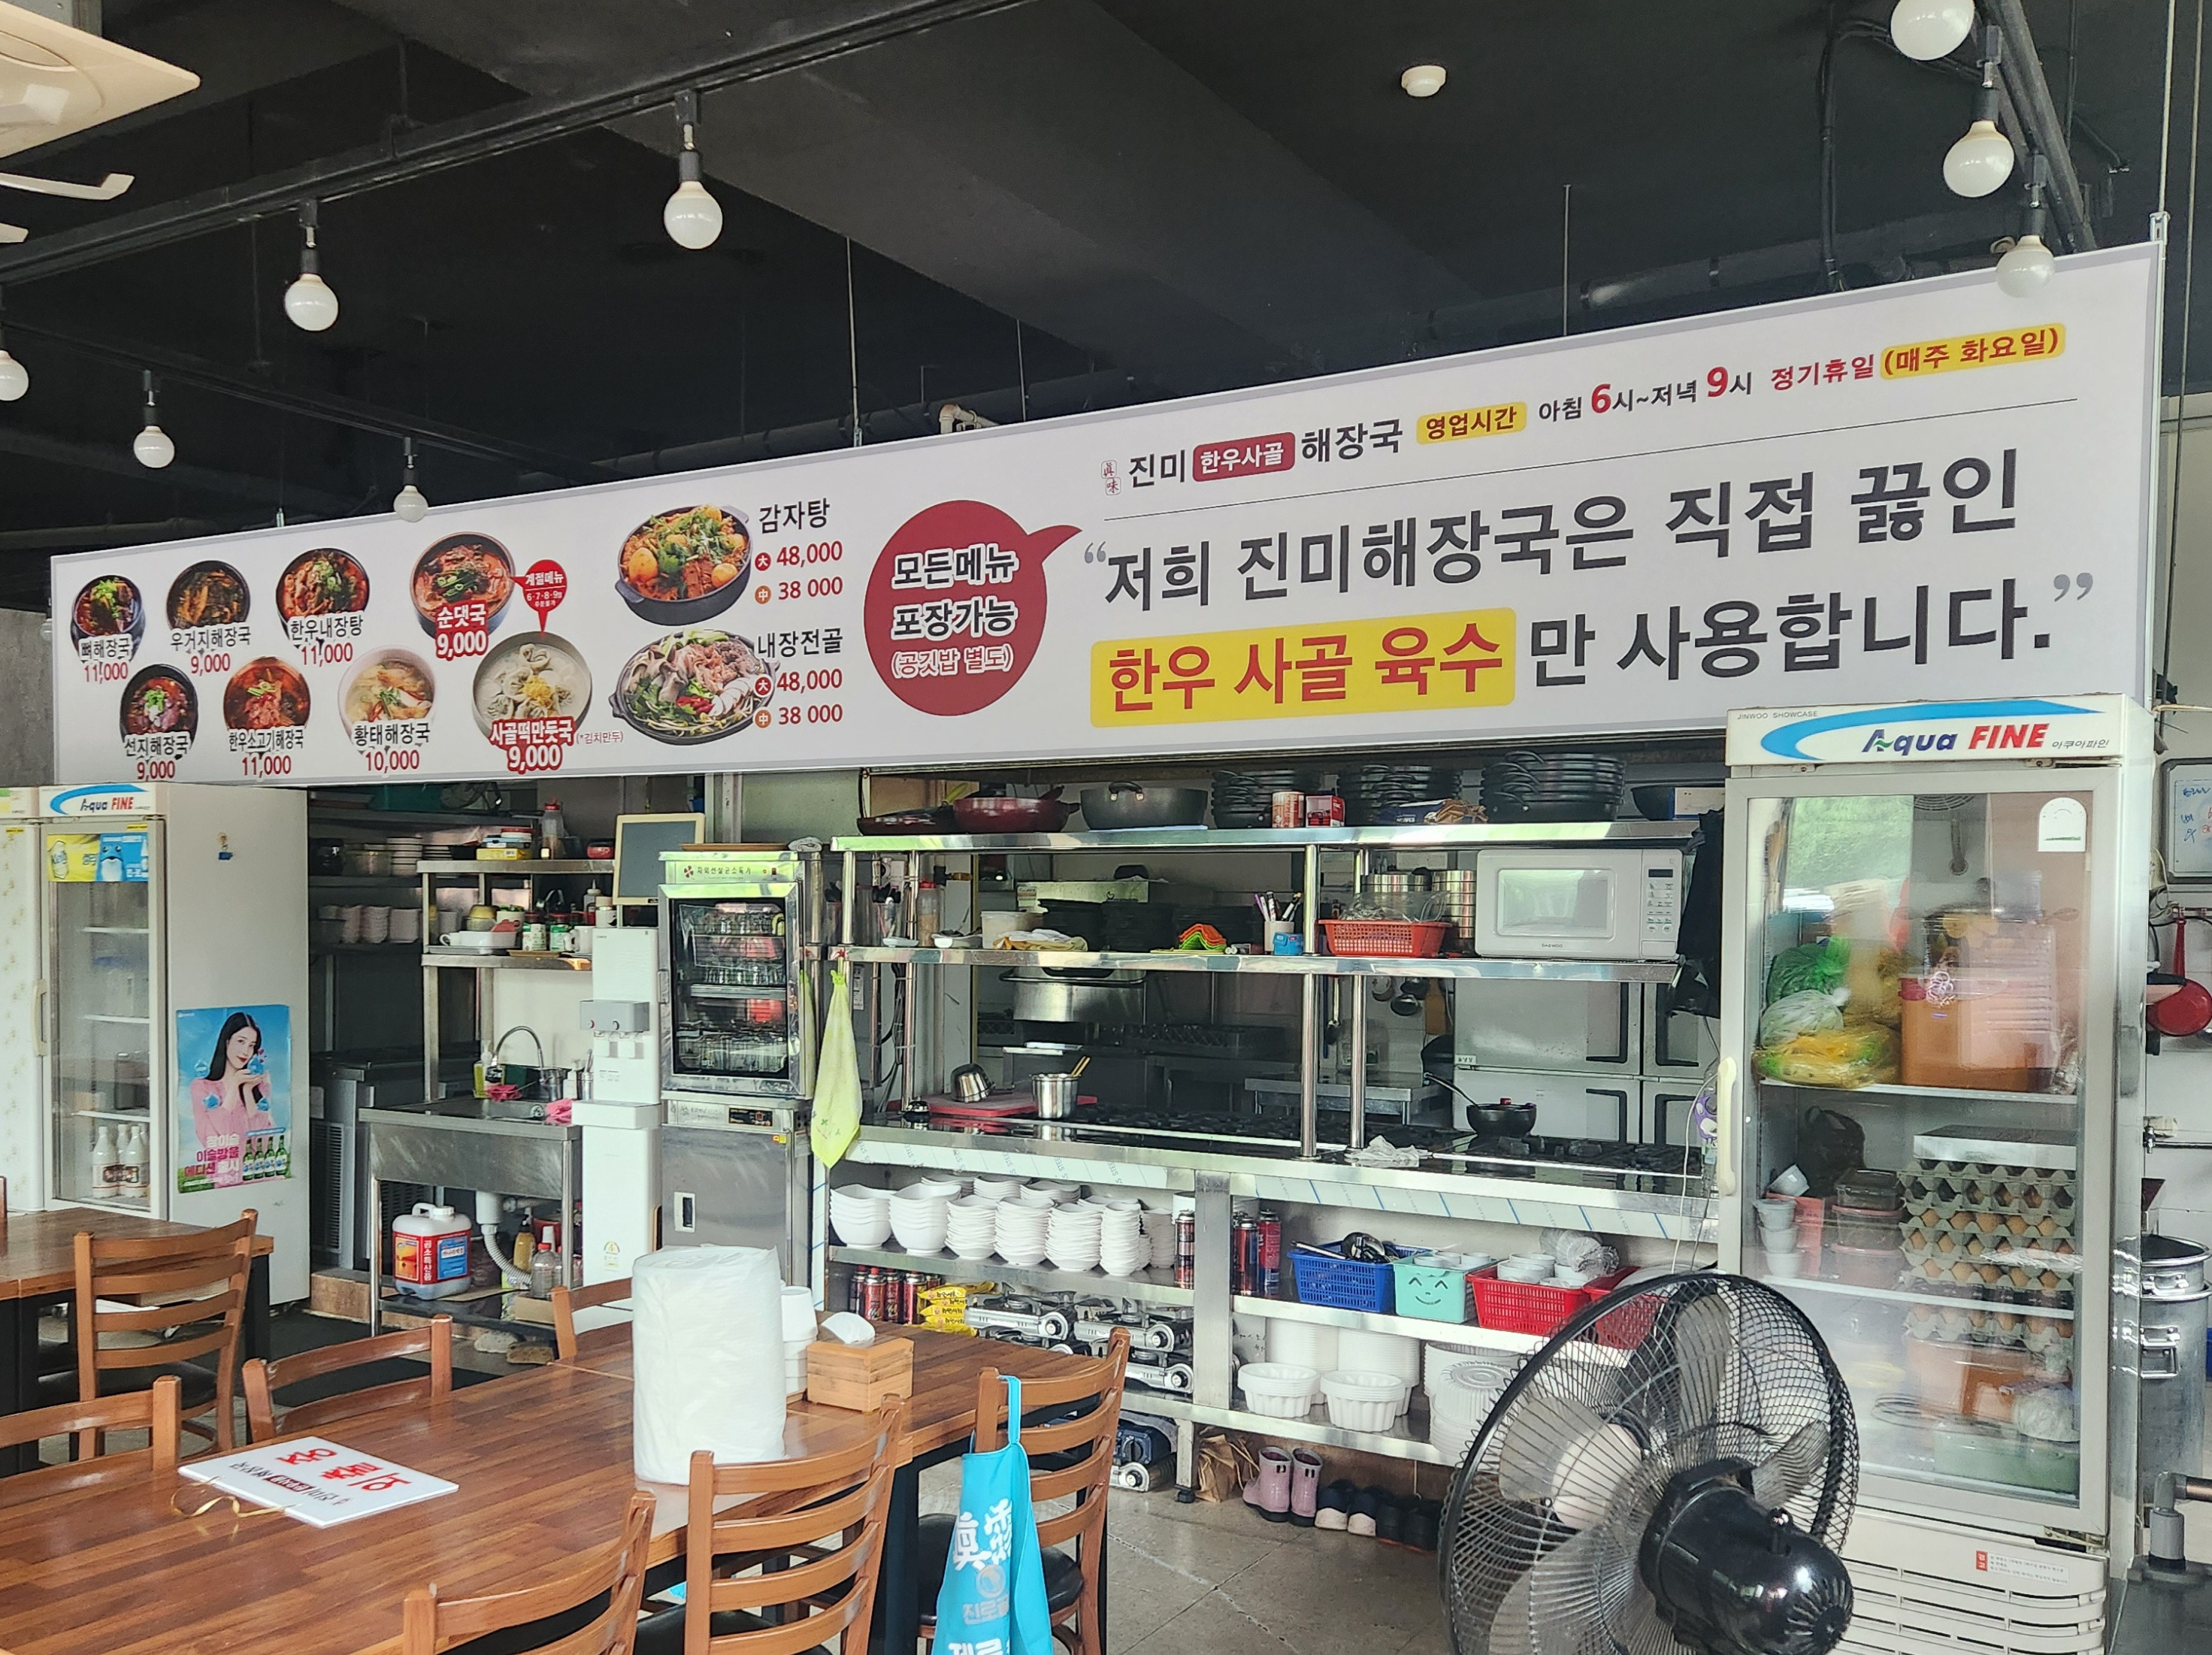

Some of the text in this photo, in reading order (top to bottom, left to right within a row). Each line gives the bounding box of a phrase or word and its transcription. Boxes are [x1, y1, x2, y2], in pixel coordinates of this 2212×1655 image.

[1770, 326, 2059, 392] 정기휴일 (매주 화요일)
[1426, 407, 1517, 440] 영업시간
[1539, 396, 1582, 422] 아침
[1707, 366, 1752, 398] 9시
[1129, 419, 1403, 488] 진미 한우사골 해장국
[758, 498, 831, 534] 감자탕
[1238, 496, 1634, 601] 진미해장국은
[1666, 471, 1814, 558] 직접
[1850, 448, 2017, 544] 끓인
[776, 540, 843, 567] 48,000
[894, 544, 1017, 586] 모든메뉴
[289, 614, 364, 643] 한우내장탕
[437, 604, 486, 630] 순댓국
[894, 600, 1015, 636] 포장가능
[80, 638, 130, 659] 뼈해장국
[170, 625, 251, 651] 우거지해장국
[437, 631, 486, 658] 9,000
[757, 628, 843, 659] 내장전골
[191, 652, 231, 676] 9,000
[301, 642, 353, 665] 11,000
[892, 644, 1014, 678] (공깃밥 별도)
[1109, 646, 1215, 712] 한우
[1234, 634, 1353, 704] 사골
[1375, 623, 1502, 696] 육수
[1530, 613, 1596, 688] 만
[84, 662, 129, 684] 11,000
[776, 668, 843, 694] 48,000
[123, 734, 189, 757] 선지해장국
[228, 728, 304, 752] 한우소고기해장국
[353, 722, 431, 747] 황태해장국
[1862, 723, 2109, 755] Aqua FINE 아쿠아파인
[136, 760, 175, 781] 9,000
[241, 755, 292, 777] 11,000
[365, 750, 419, 773] 10,000
[508, 746, 561, 771] 9,000
[80, 797, 134, 812] Aqua FINE
